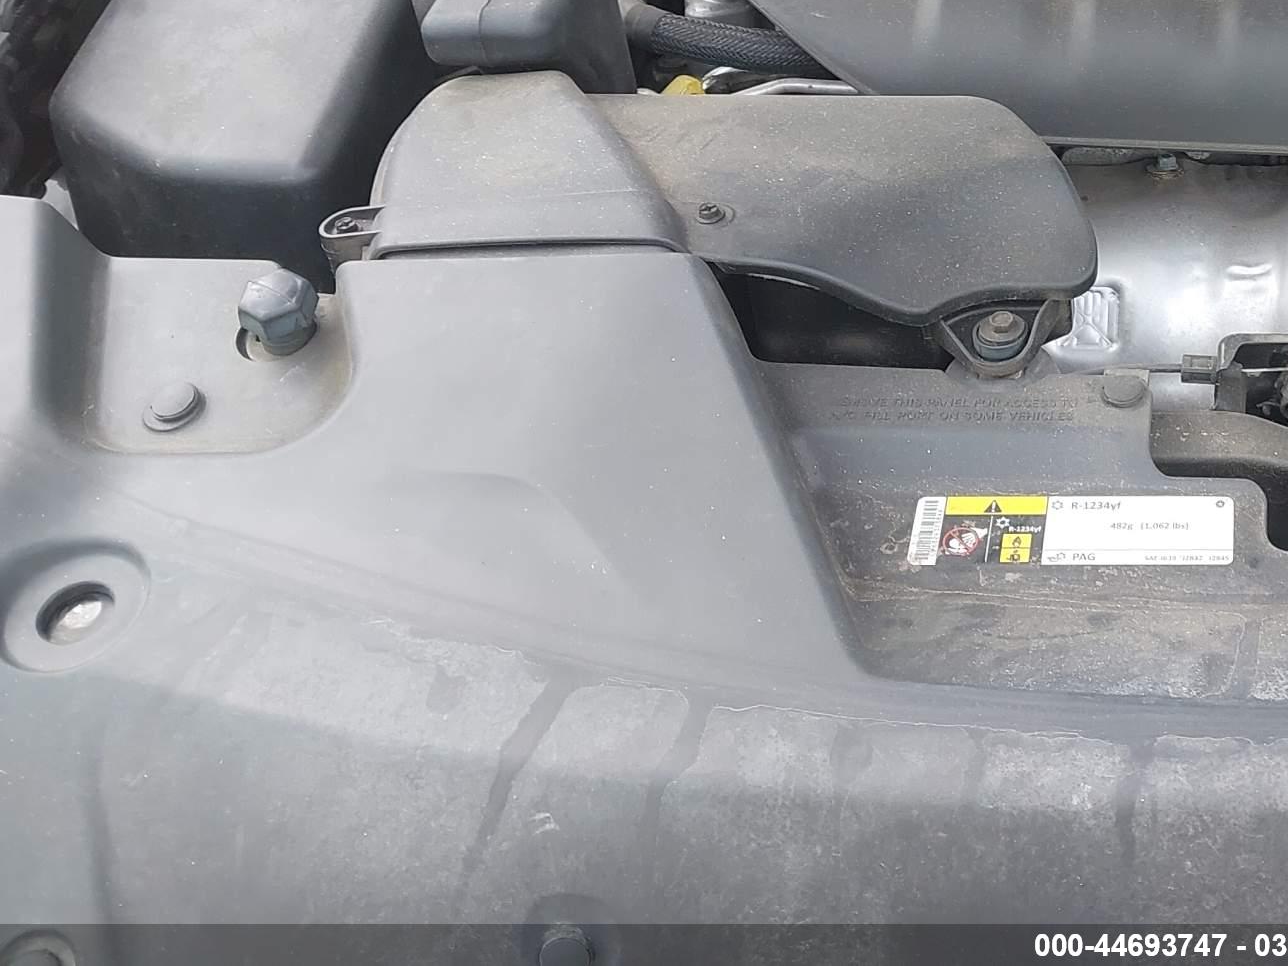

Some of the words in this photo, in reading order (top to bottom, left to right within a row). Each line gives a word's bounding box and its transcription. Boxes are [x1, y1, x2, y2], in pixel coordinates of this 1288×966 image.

[1071, 501, 1121, 512] R-1234yf
[1008, 525, 1042, 534] R-1234yf
[1072, 553, 1096, 561] PAG
